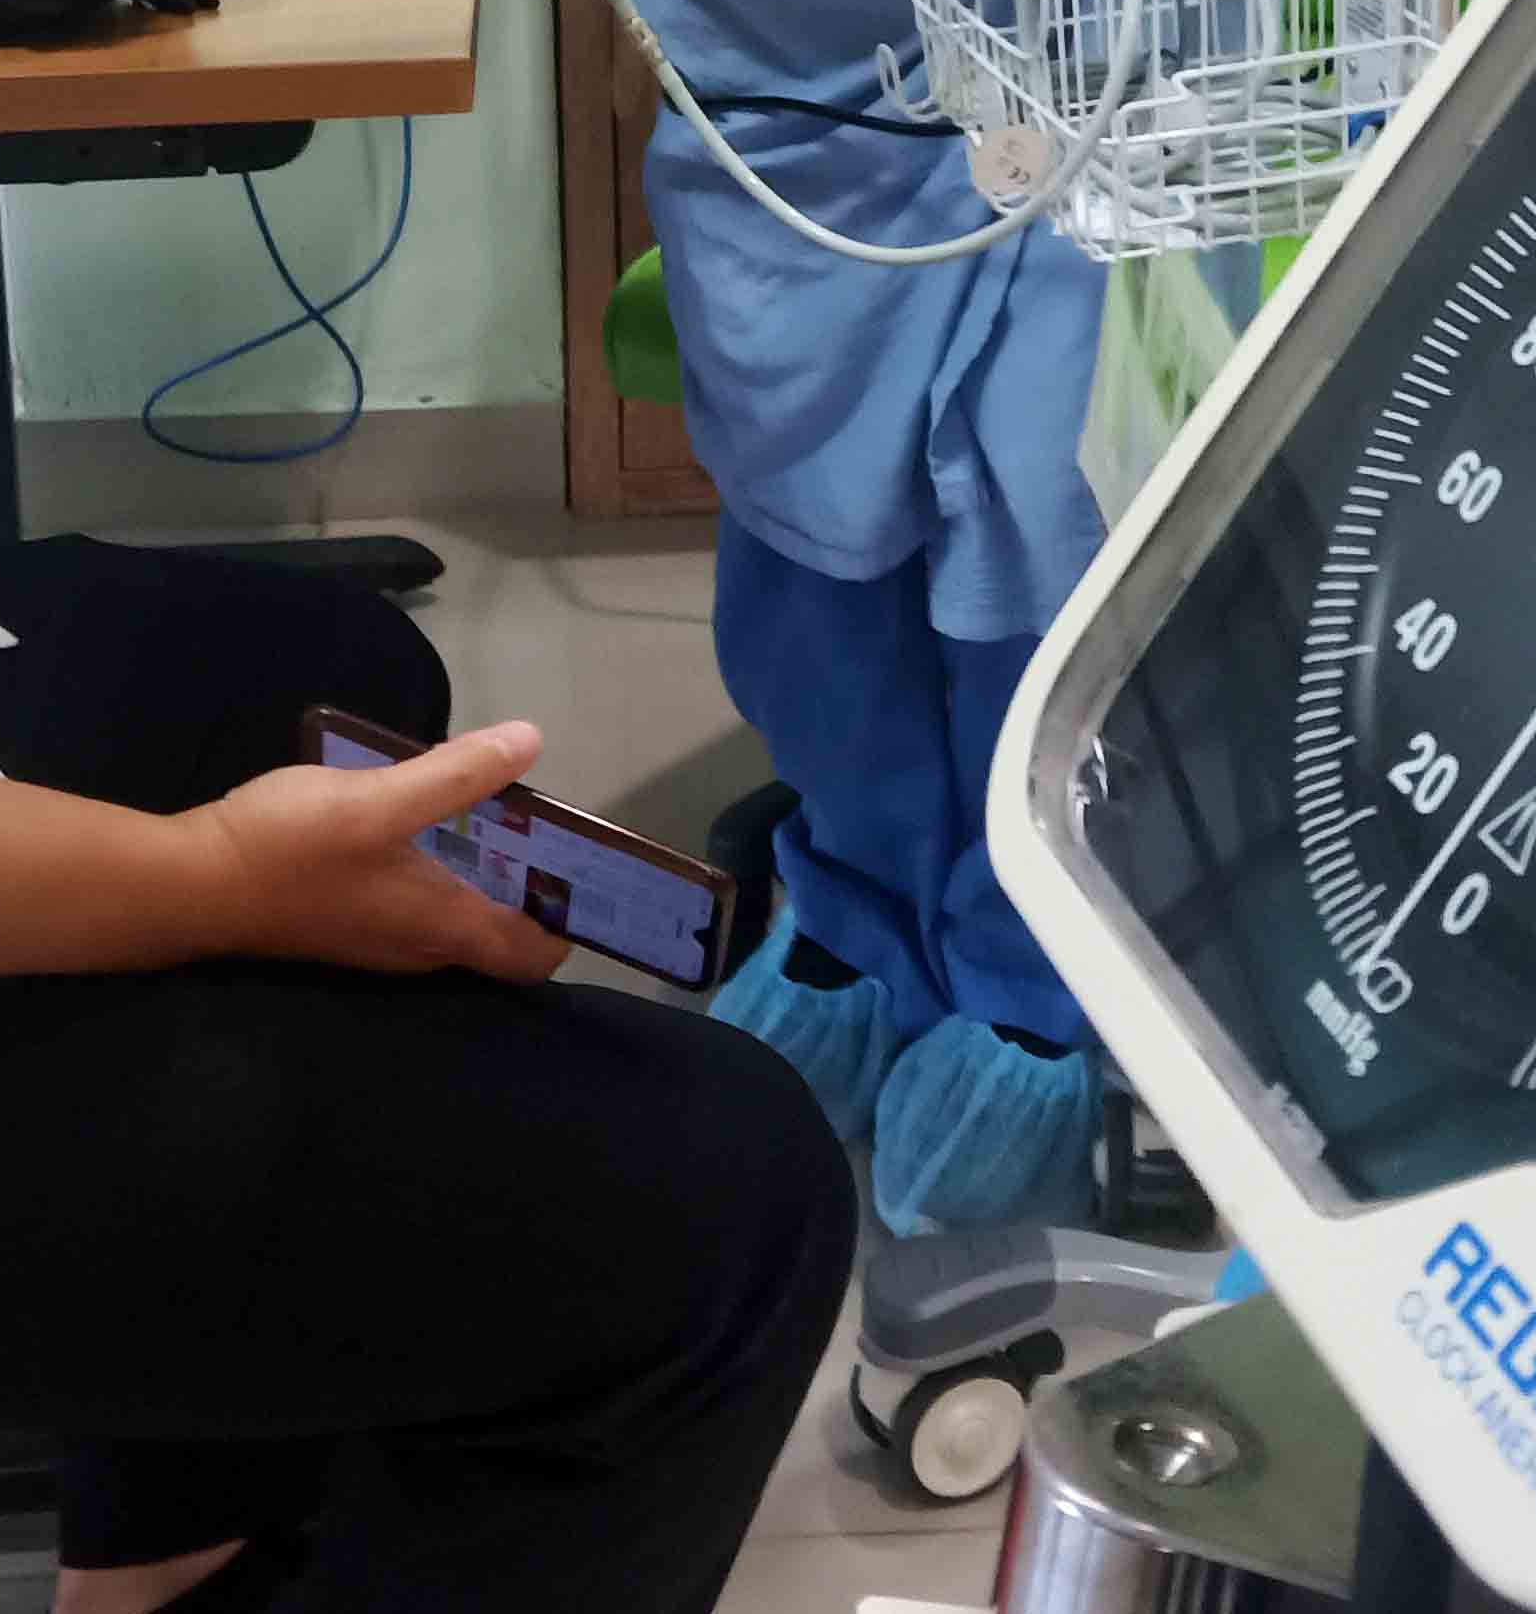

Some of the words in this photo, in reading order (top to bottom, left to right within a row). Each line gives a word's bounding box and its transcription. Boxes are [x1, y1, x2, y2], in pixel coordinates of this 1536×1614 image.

[1437, 449, 1503, 523] 60
[1393, 598, 1458, 672] 40
[1387, 731, 1460, 814] 20
[1442, 872, 1489, 935] 0
